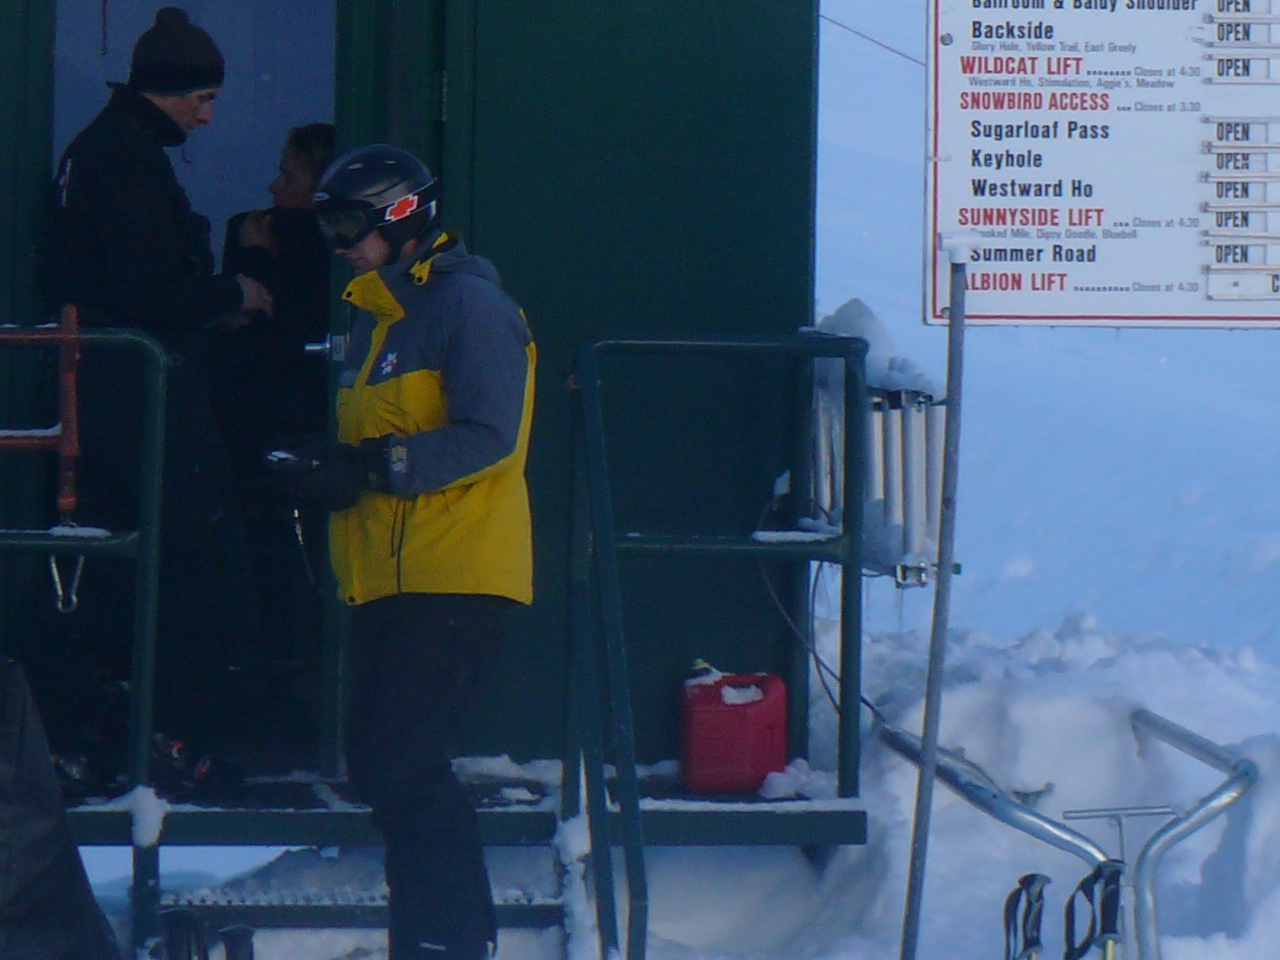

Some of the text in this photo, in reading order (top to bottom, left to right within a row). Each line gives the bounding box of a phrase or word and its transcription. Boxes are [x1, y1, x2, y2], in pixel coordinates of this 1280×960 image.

[972, 21, 1053, 39] Backside
[1217, 24, 1250, 41] OPEN
[960, 56, 1038, 75] WILDCAT
[1047, 57, 1083, 75] LIFT
[1217, 59, 1250, 77] OPEN
[960, 92, 1042, 110] SNOWBIRD
[1048, 93, 1110, 111] ACCESS
[971, 120, 1110, 140] Sugarloaf Pass
[1217, 123, 1249, 141] OPEN
[971, 150, 1042, 170] Keyhole
[1217, 153, 1249, 169] OPEN
[971, 179, 1093, 197] Westward Ho
[1216, 182, 1249, 199] OPEN
[958, 208, 1059, 226] SUNNYSIDE
[1069, 209, 1104, 226] LIFT
[1216, 212, 1248, 227] OPEN
[970, 246, 1096, 262] Summer Road
[1216, 245, 1248, 263] OPEN
[1031, 274, 1067, 291] LIFT
